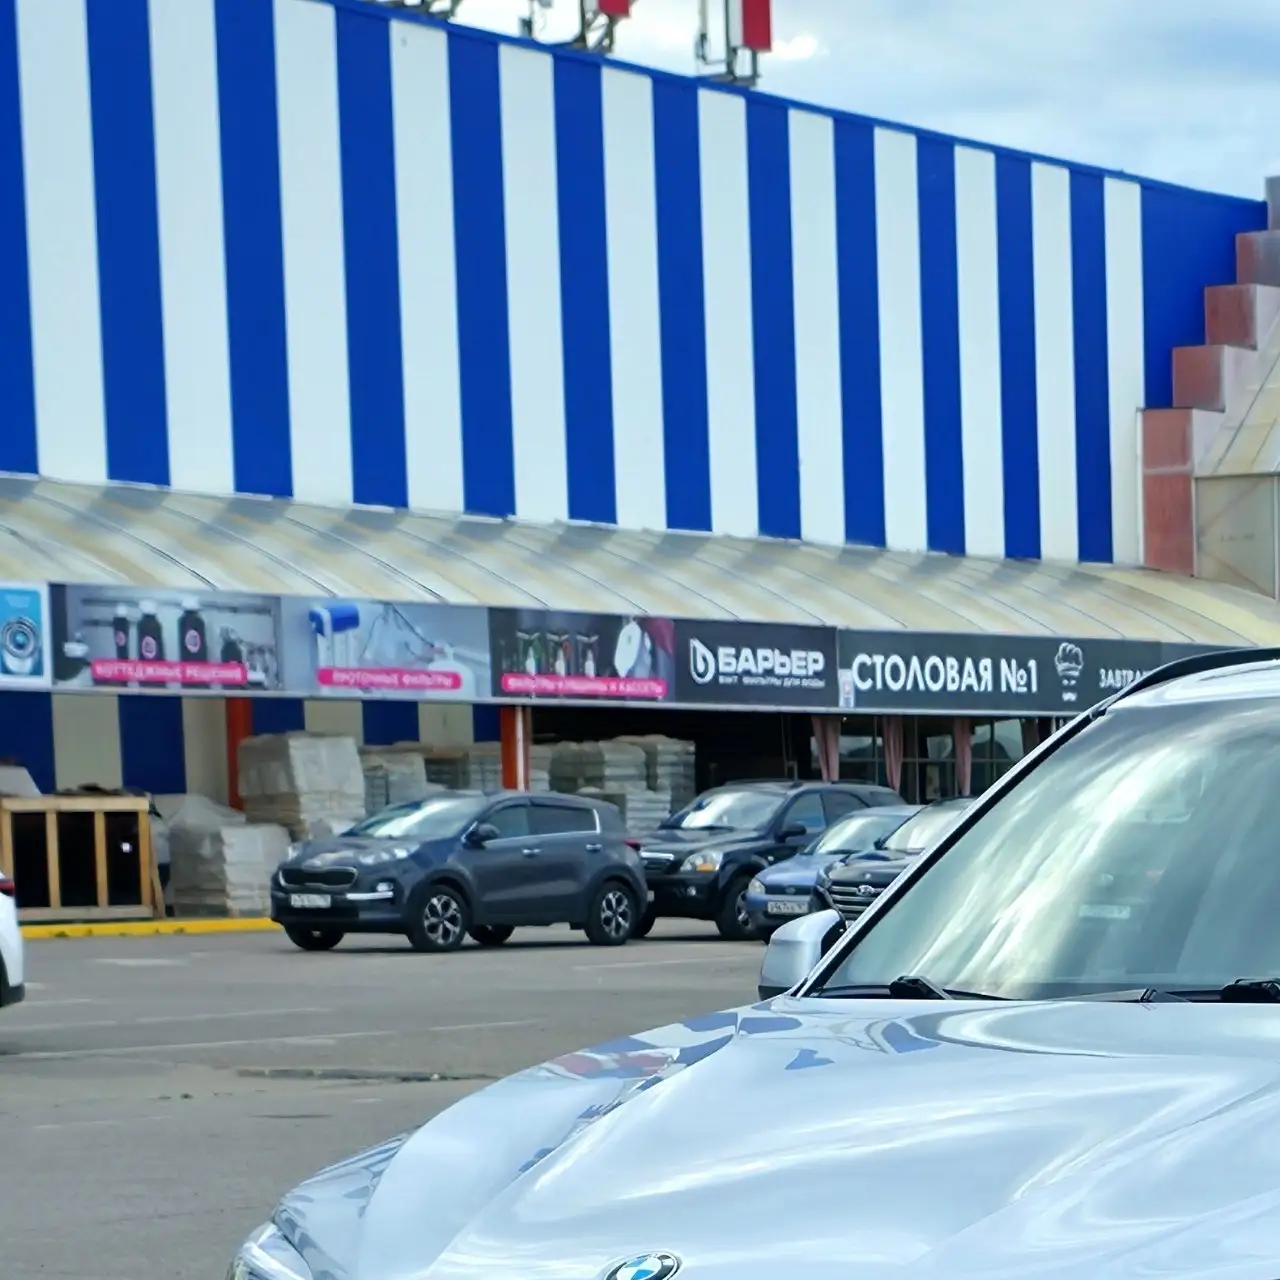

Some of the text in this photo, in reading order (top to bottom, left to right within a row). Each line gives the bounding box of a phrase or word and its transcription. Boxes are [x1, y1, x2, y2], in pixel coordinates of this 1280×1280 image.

[717, 645, 825, 677] БАРЬЕР
[852, 653, 1038, 694] СТОЛОВАЯ №1
[1098, 667, 1152, 690] ЗАВТРА
